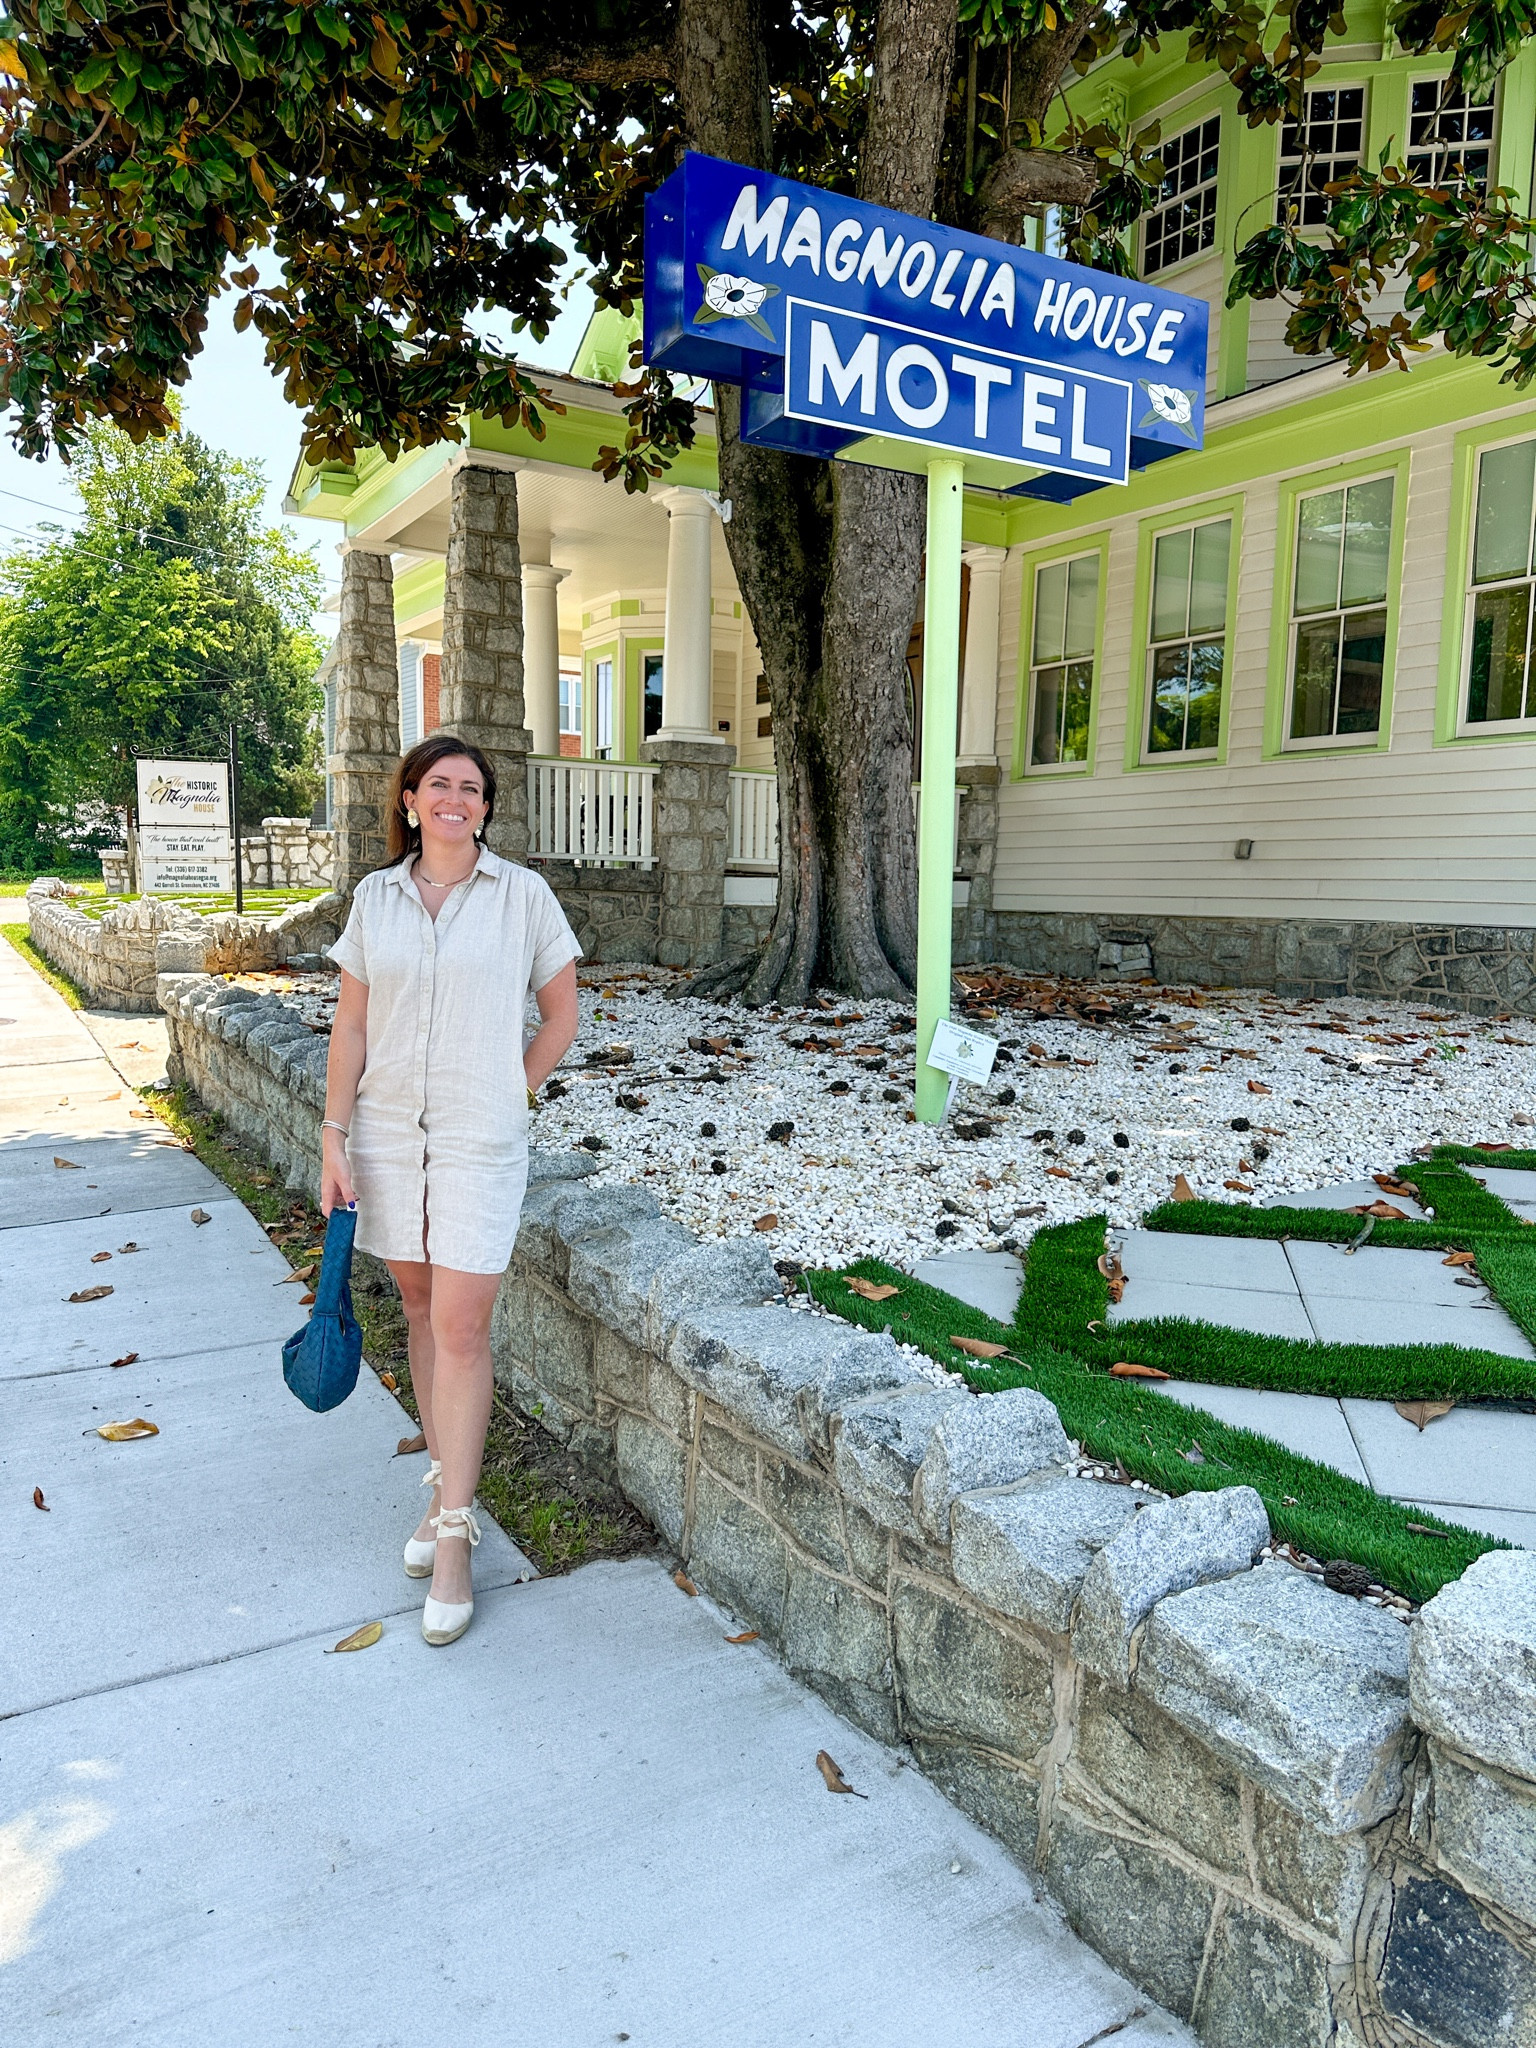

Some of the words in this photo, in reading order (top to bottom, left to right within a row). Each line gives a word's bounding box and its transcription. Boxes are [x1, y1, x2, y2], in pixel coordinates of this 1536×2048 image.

[721, 184, 1017, 329] MAGNOLIA
[1034, 278, 1186, 365] HOUSE
[808, 320, 1112, 467] MOTEL
[166, 776, 186, 788] The
[187, 781, 217, 791] HISTORIC
[152, 786, 222, 809] Magnolia
[193, 804, 215, 813] HOUSE
